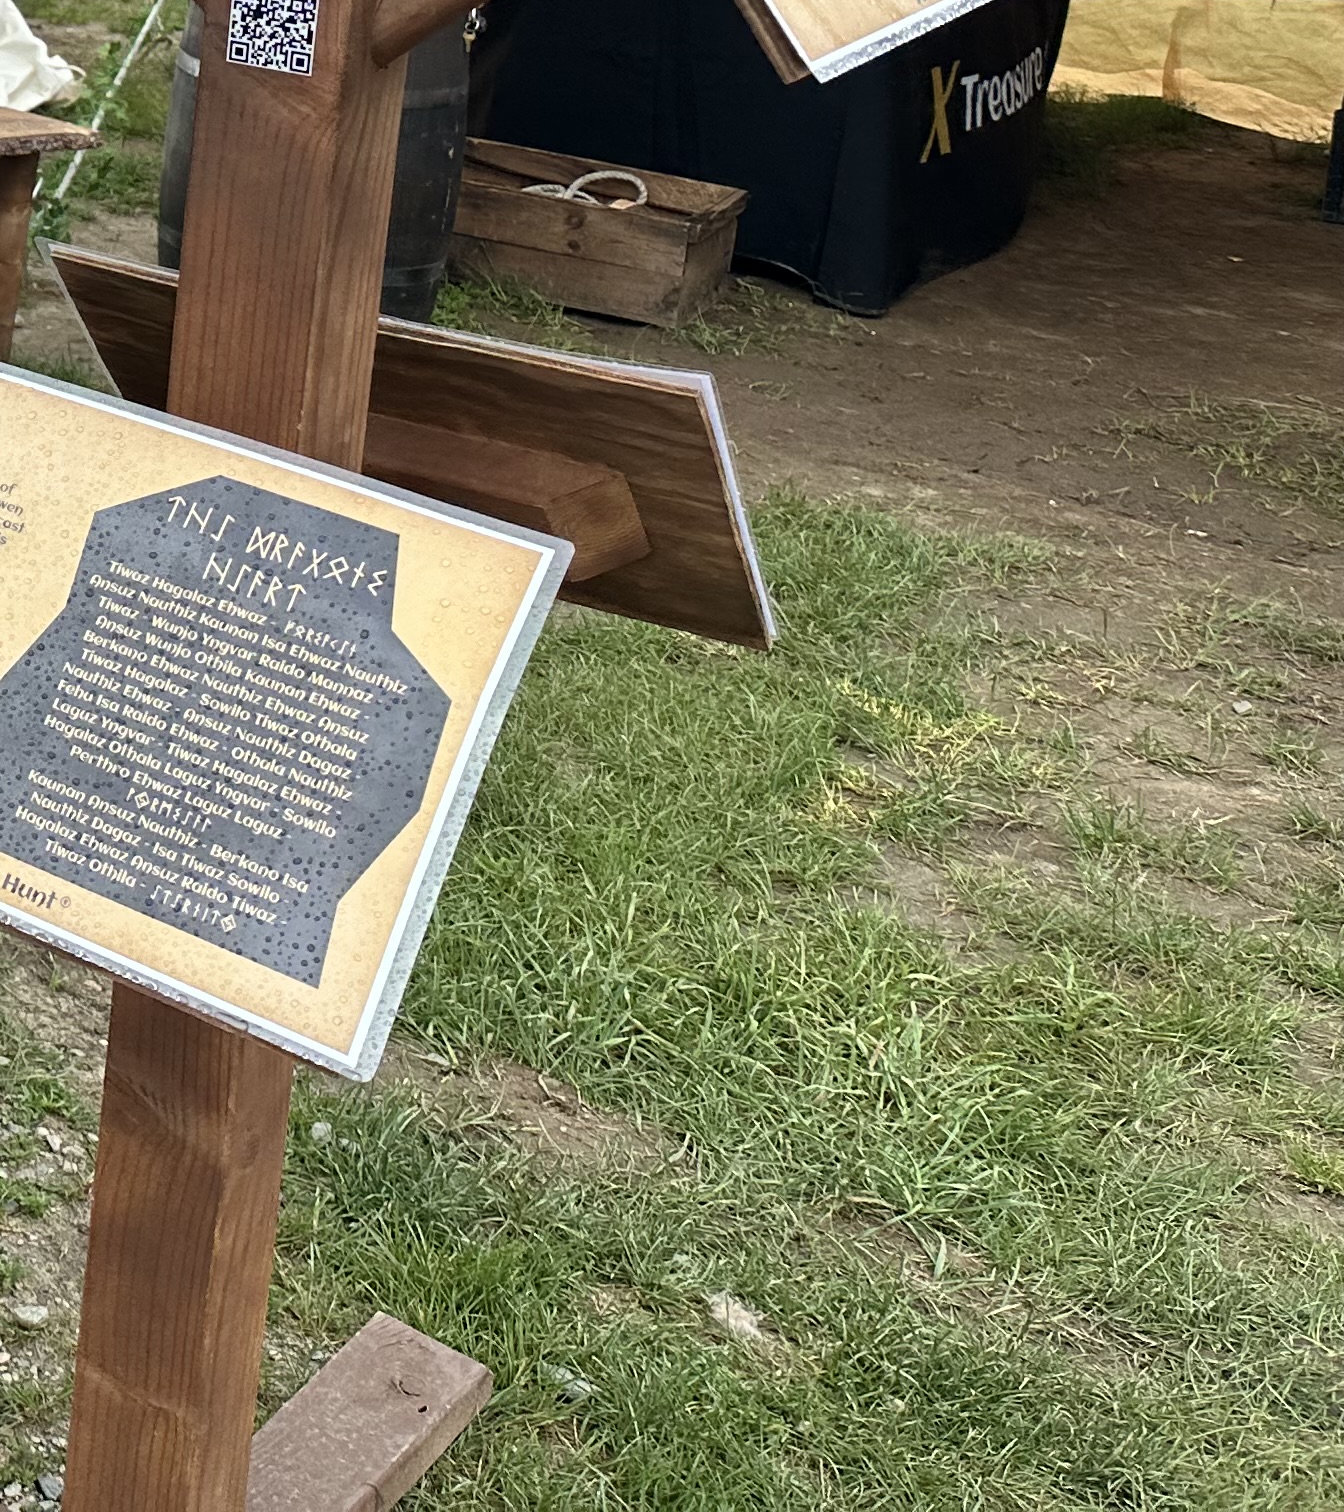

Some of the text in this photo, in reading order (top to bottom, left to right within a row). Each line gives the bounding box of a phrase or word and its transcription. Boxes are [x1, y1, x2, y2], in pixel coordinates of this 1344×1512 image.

[919, 45, 1044, 165] X Treasure
[88, 573, 410, 697] Ansuz Nauthiz Kaunan Isa Ehwaz Nauthiz
[98, 593, 375, 705] Tiwaz Wunjo Yngvar Raido Mannaz
[108, 559, 269, 627] Tiwaz Hagalaz Ehwaz
[61, 660, 354, 781] Nauthiz Ehwaz Ansuz Nauthiz Dagaz
[80, 646, 359, 762] Tiwaz Hagalaz Sowilo Tiwaz Othala
[81, 628, 371, 745] Berkano Ehwaz Nauthiz Ehwaz Ansuz
[94, 614, 363, 721] Ansuz Wunjo Othila Kaunan Ehwaz
[42, 713, 338, 840] Hagalaz Othala Laguz Yngvar Sowilo
[51, 696, 334, 817] Laguz Yngvar Tiwaz Hagalaz Ehwaz
[56, 678, 356, 802] Fehu Isa Raido Ehwaz Othala Nauthiz
[68, 744, 284, 840] Perthro Ehwaz Laguz Laguz
[14, 804, 278, 926] Hagalaz Ehwaz Ansuz Raido Tiwaz
[26, 768, 310, 895] Kaunan Ansuz Nauthiz Berkano Isa
[29, 790, 281, 904] Nauthiz Dagaz Isa Tiwaz Sowilo
[44, 837, 137, 888] Tiwaz Othila
